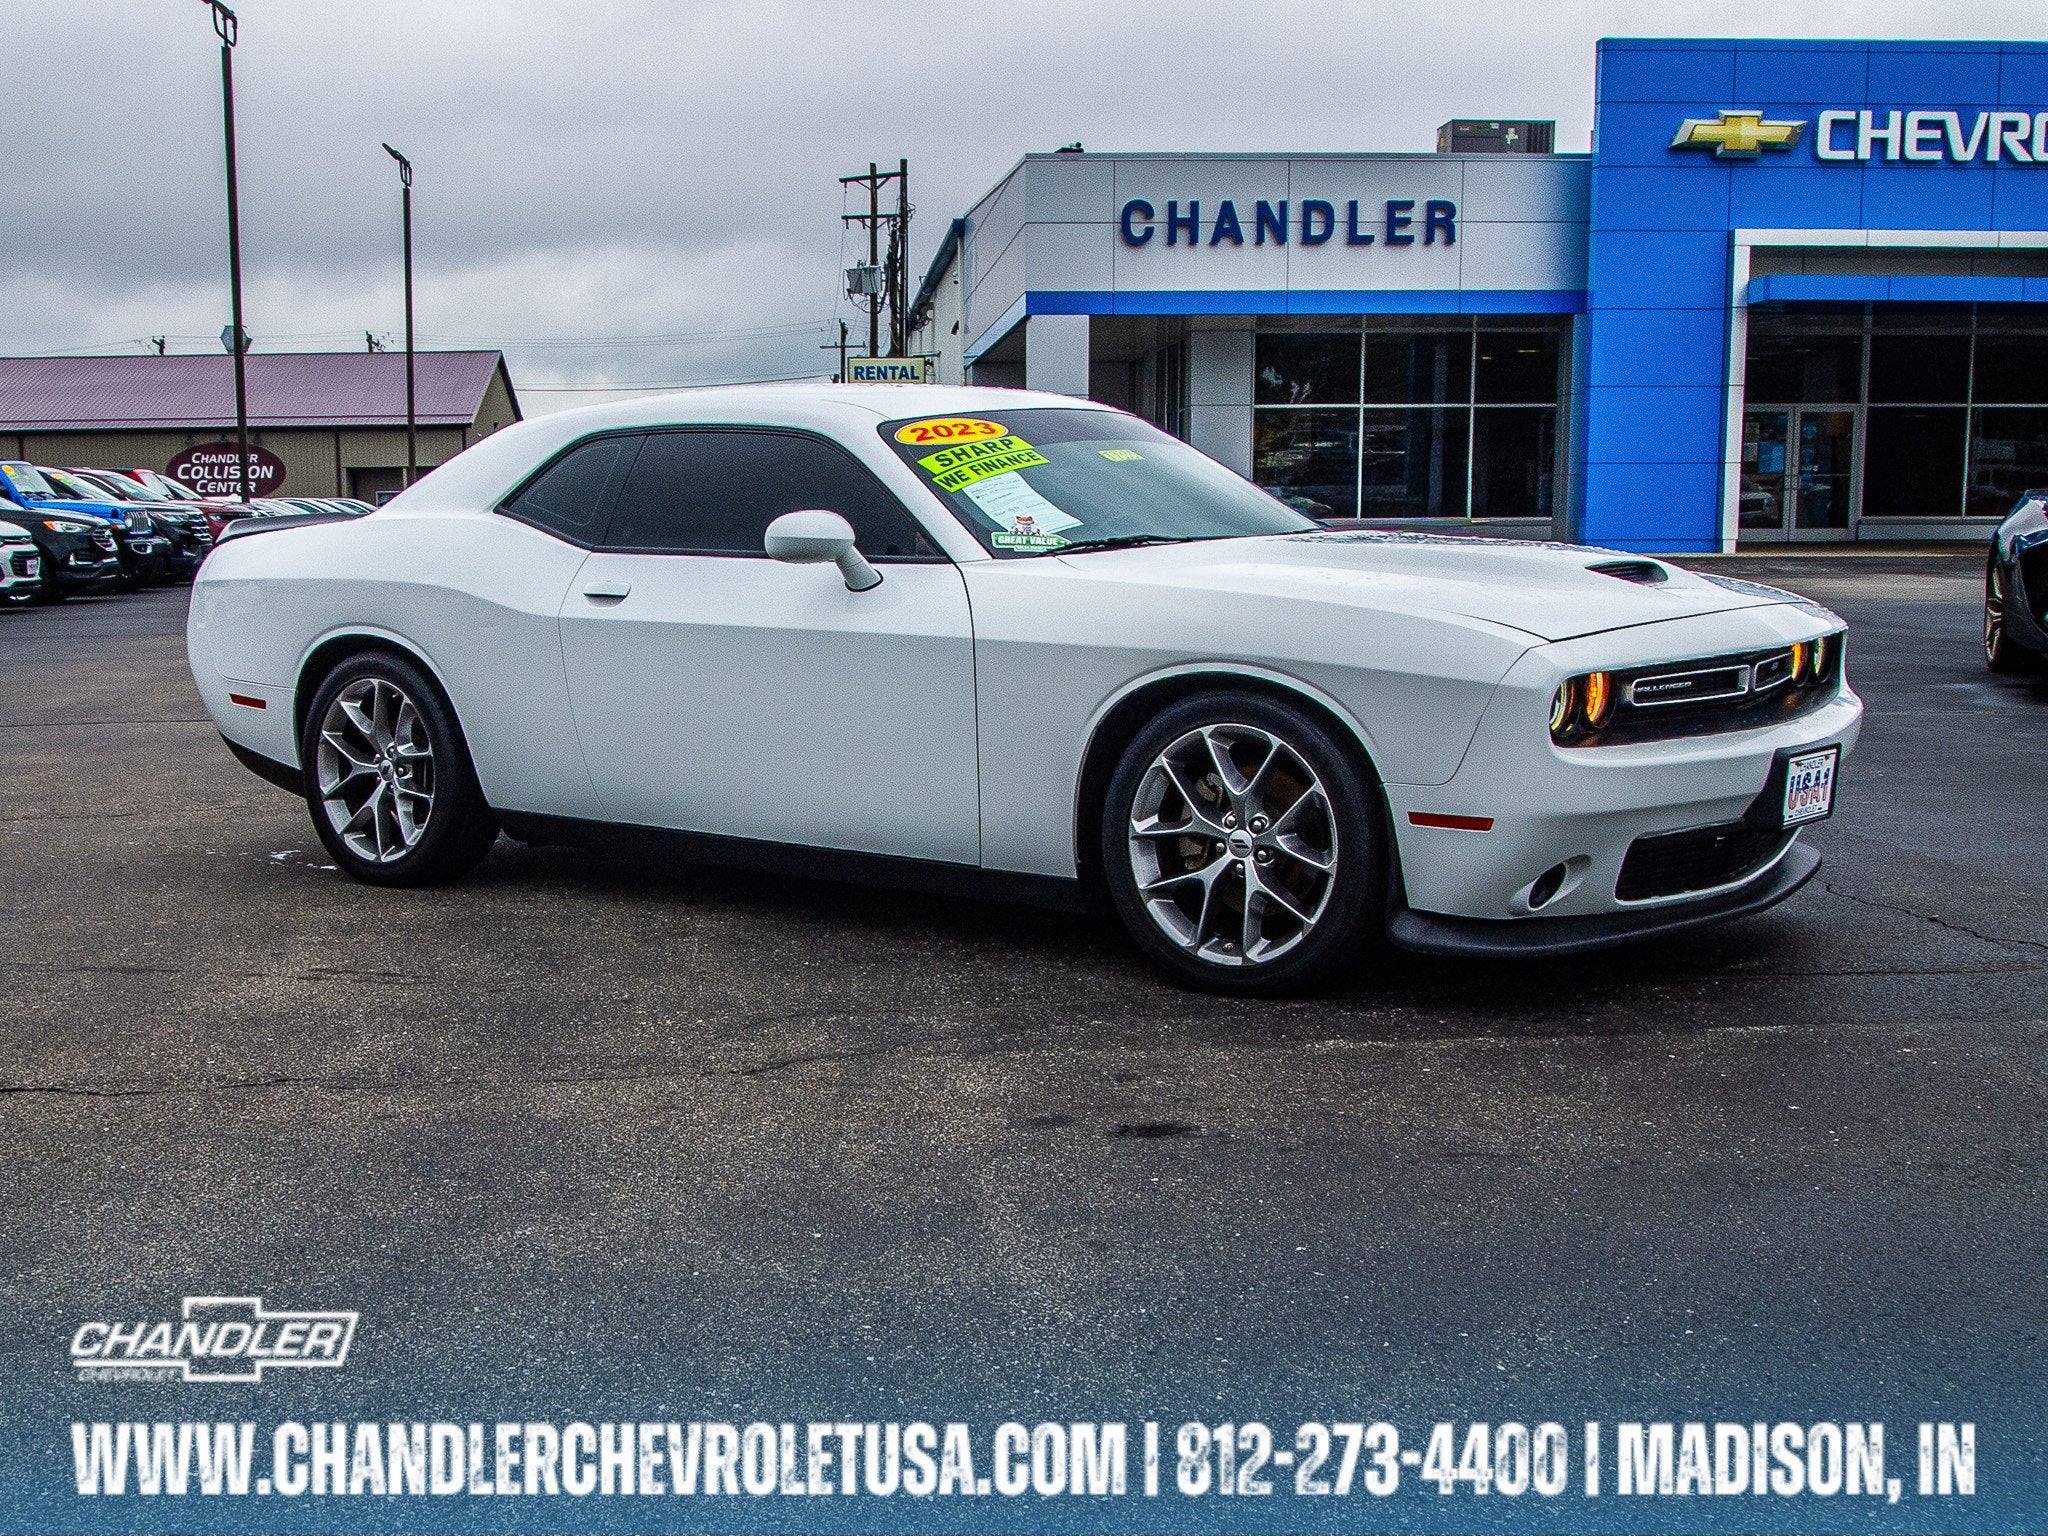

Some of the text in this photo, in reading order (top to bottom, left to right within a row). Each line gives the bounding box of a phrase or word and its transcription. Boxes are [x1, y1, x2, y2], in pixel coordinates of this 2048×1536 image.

[1119, 198, 1457, 246] CHANDLER
[854, 366, 919, 380] RENTAL
[910, 422, 996, 442] 2023
[191, 453, 258, 463] CHANDLR
[934, 438, 1014, 468] SHARP
[177, 464, 274, 479] COLLISON
[937, 451, 1041, 489] WE FINANCE
[998, 535, 1059, 546] GREAT VALUE
